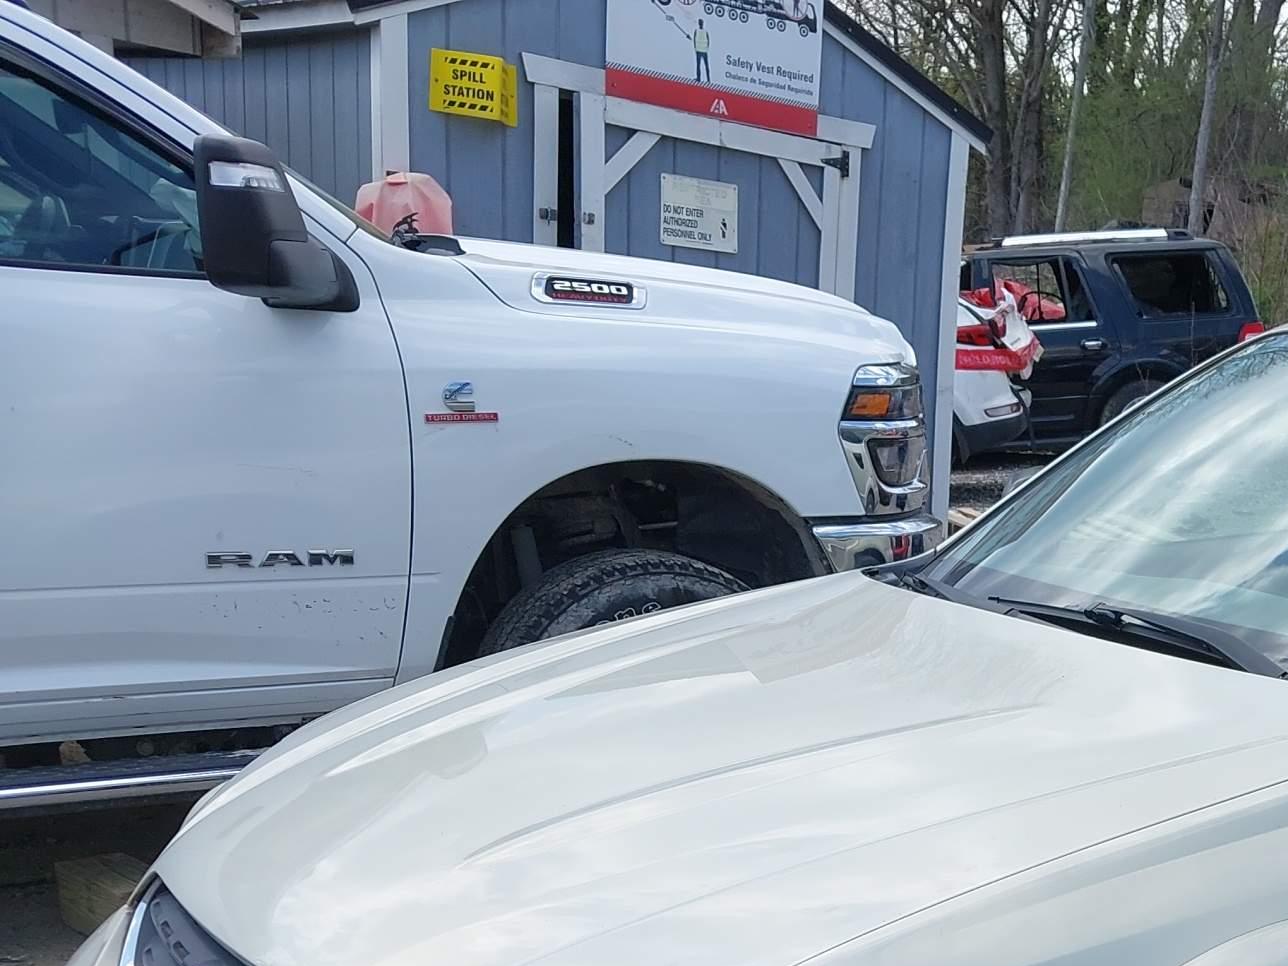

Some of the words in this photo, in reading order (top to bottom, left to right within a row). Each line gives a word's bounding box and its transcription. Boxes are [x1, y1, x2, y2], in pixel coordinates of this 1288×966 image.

[451, 68, 487, 84] SPILL
[725, 54, 753, 72] Safety
[755, 61, 775, 76] Vest
[776, 65, 814, 84] Required
[749, 76, 757, 84] de
[443, 84, 495, 102] STATION
[663, 203, 672, 213] DO
[672, 205, 685, 216] NOT
[685, 207, 704, 218] ENTER
[663, 215, 699, 229] AUTHORIZED
[663, 227, 697, 240] PERSONNEL
[697, 231, 712, 242] ONLY
[551, 280, 628, 295] 2500
[427, 414, 461, 422] TURBO
[462, 413, 497, 421] DIESEL
[205, 549, 355, 568] RAM
